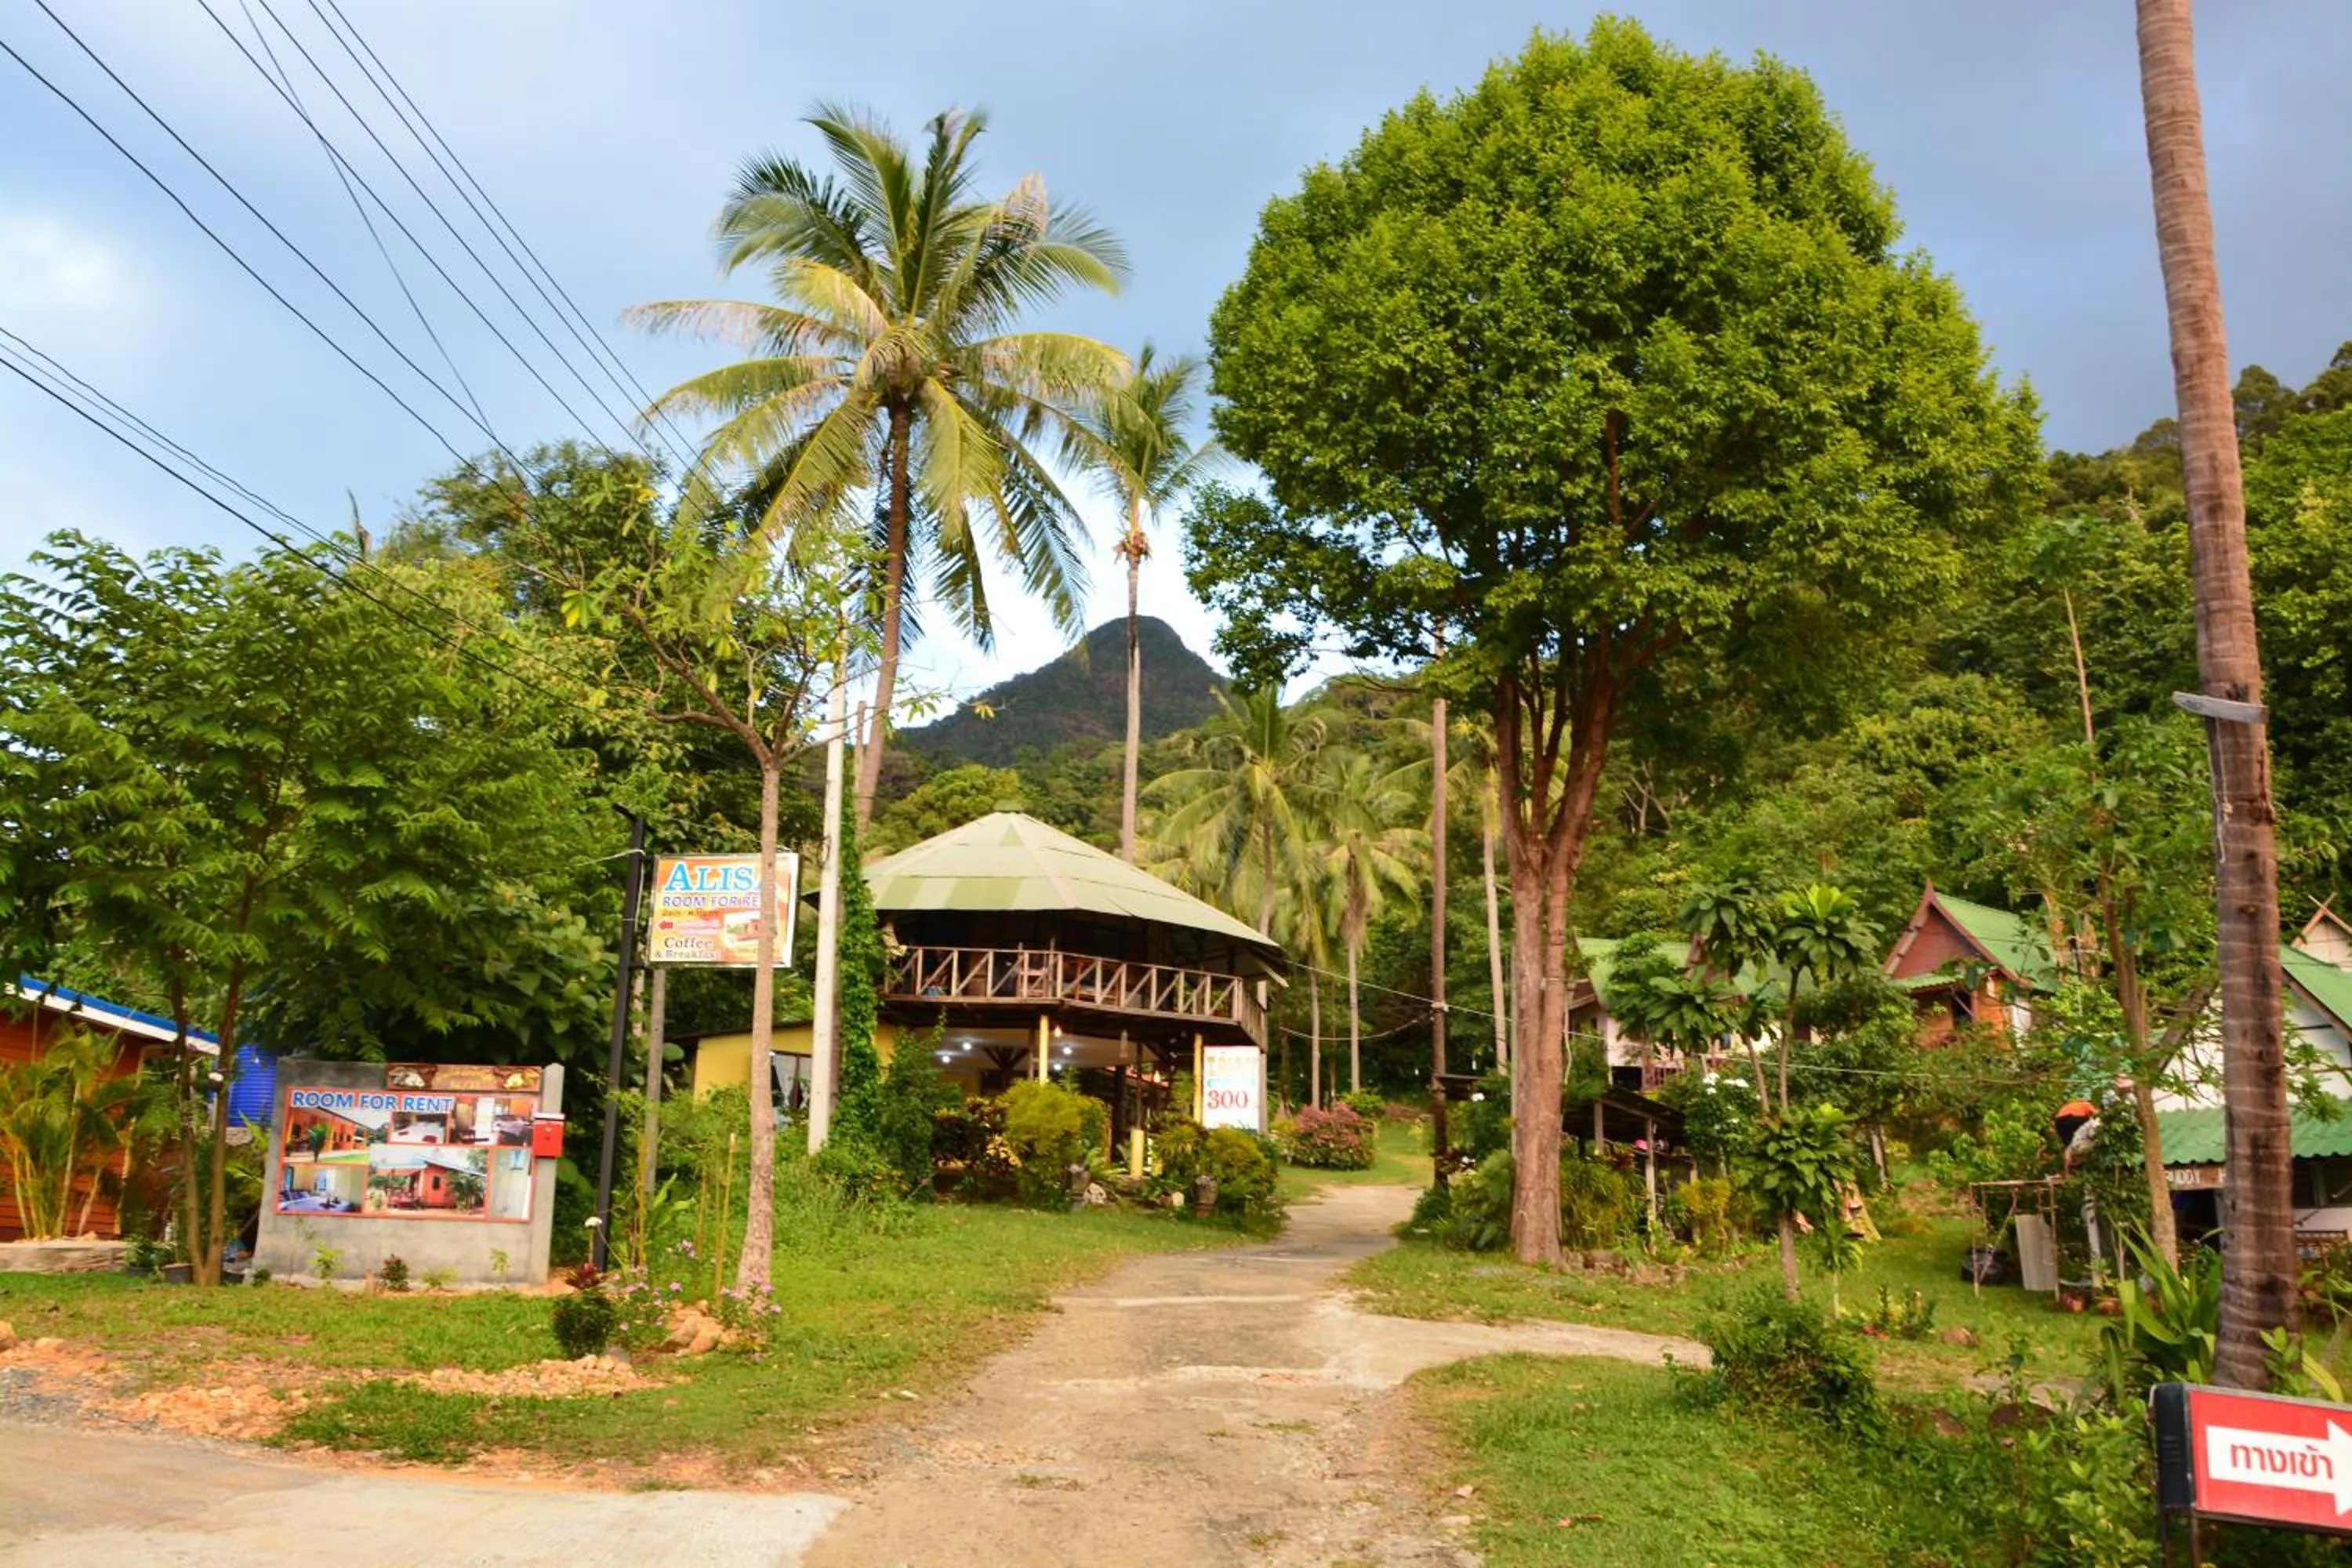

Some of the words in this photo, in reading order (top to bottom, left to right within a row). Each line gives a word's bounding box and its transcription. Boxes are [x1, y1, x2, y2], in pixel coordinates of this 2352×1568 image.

[663, 896, 706, 907] ROOM
[711, 896, 741, 907] FOR
[664, 937, 713, 949] Coffee
[292, 1091, 353, 1107] ROOM
[360, 1094, 397, 1110] FOR
[404, 1097, 453, 1112] RENT
[1207, 1090, 1248, 1109] 300
[2230, 1443, 2333, 1479] ทางเข้า
